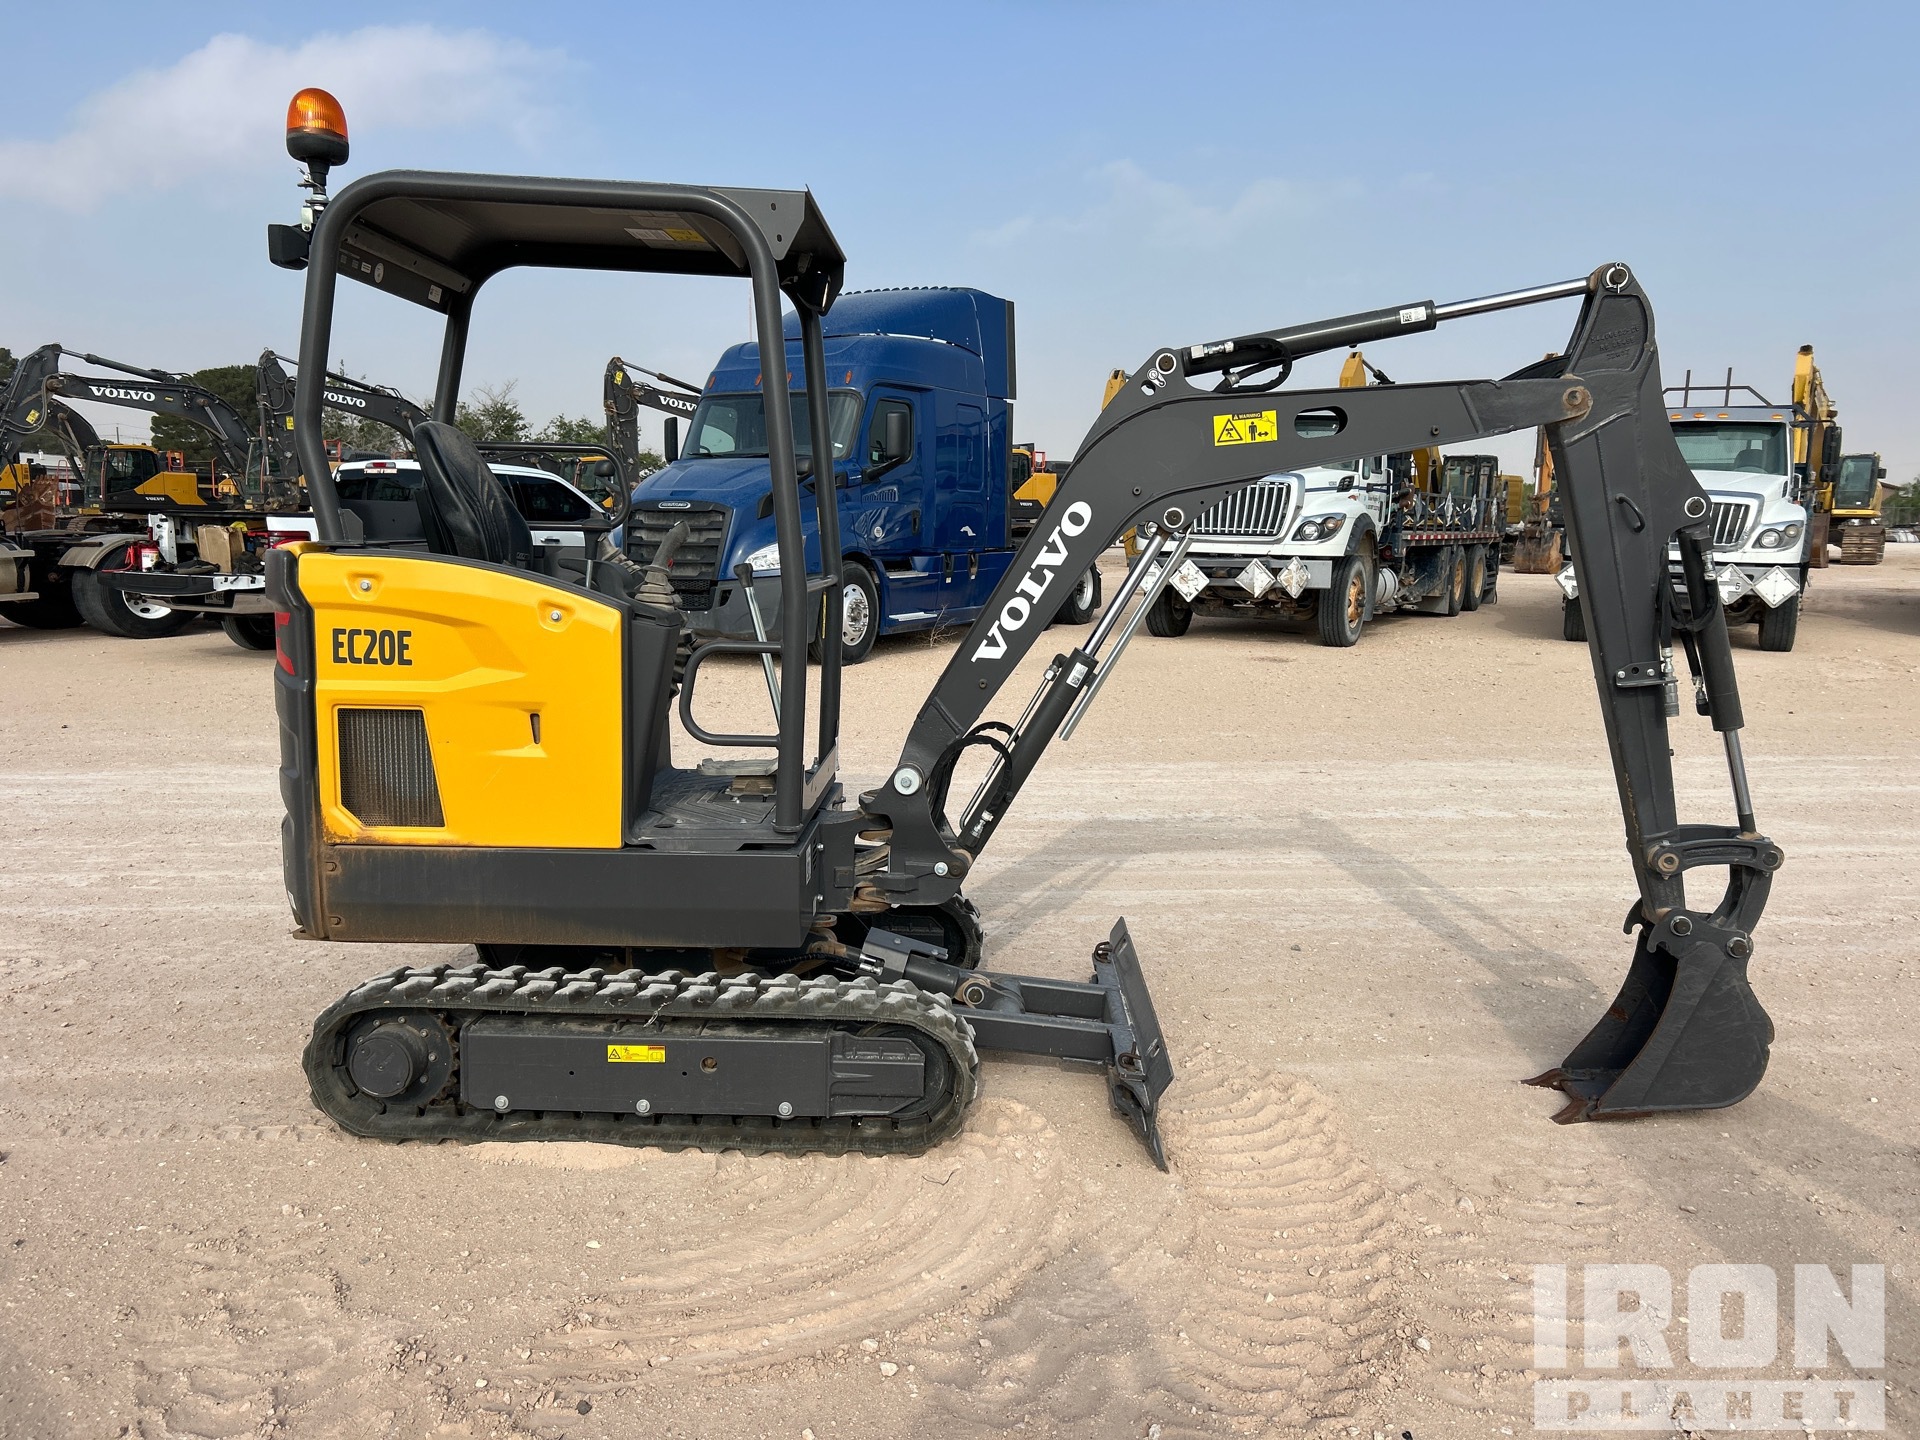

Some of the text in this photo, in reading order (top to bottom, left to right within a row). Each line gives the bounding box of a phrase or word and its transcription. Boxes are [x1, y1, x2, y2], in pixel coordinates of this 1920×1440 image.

[88, 385, 156, 402] VOLVO
[658, 395, 697, 411] VOLV
[970, 501, 1092, 663] VOLVO
[1735, 582, 1741, 591] 5
[332, 628, 413, 666] EC20E
